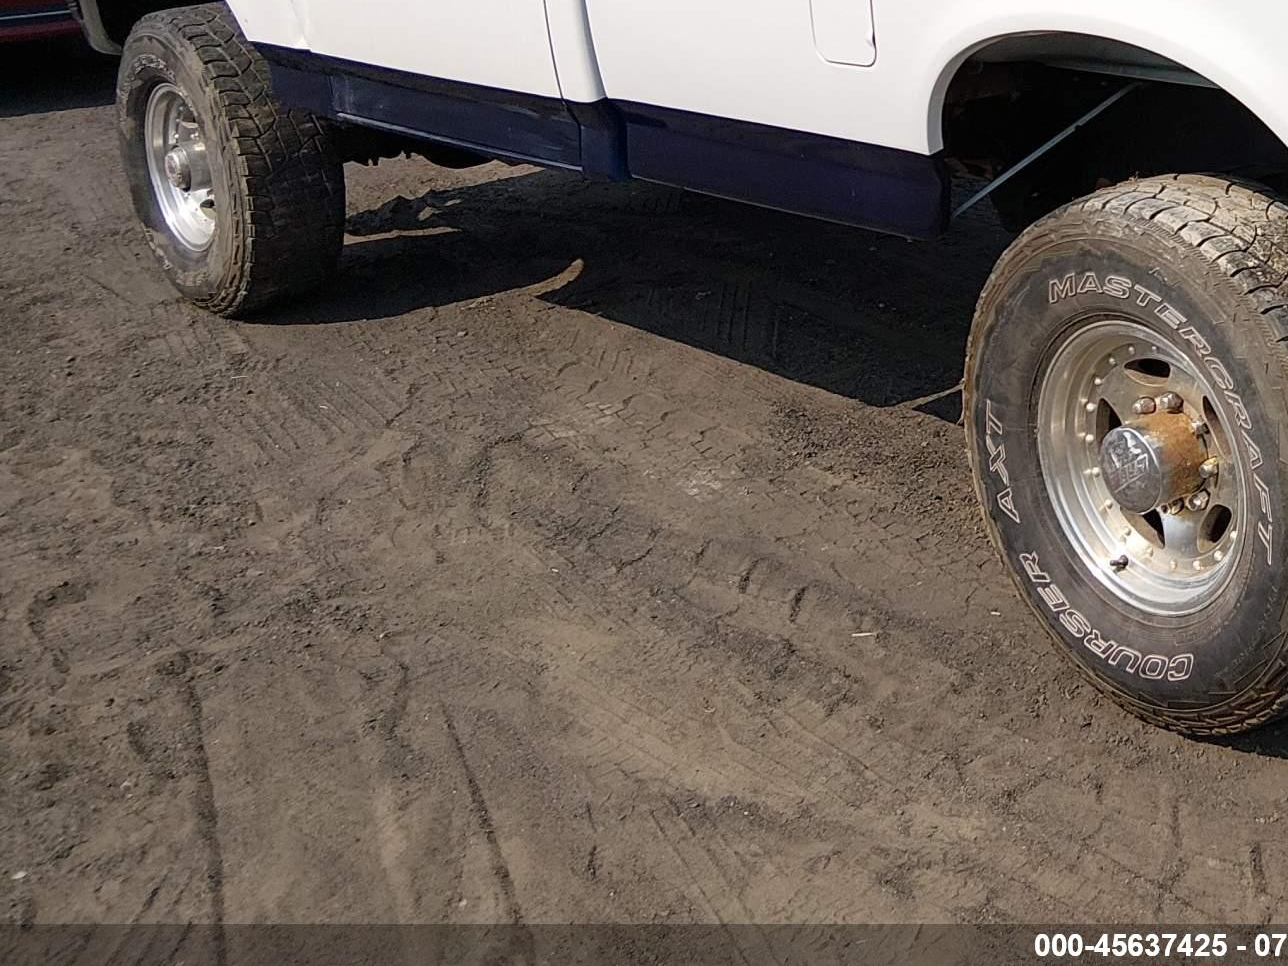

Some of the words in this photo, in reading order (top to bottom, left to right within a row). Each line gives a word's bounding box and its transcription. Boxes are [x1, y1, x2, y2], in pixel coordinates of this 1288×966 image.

[985, 398, 1021, 524] AXT
[1048, 271, 1273, 566] MASTERCRAFT
[1018, 549, 1195, 682] COURSER
